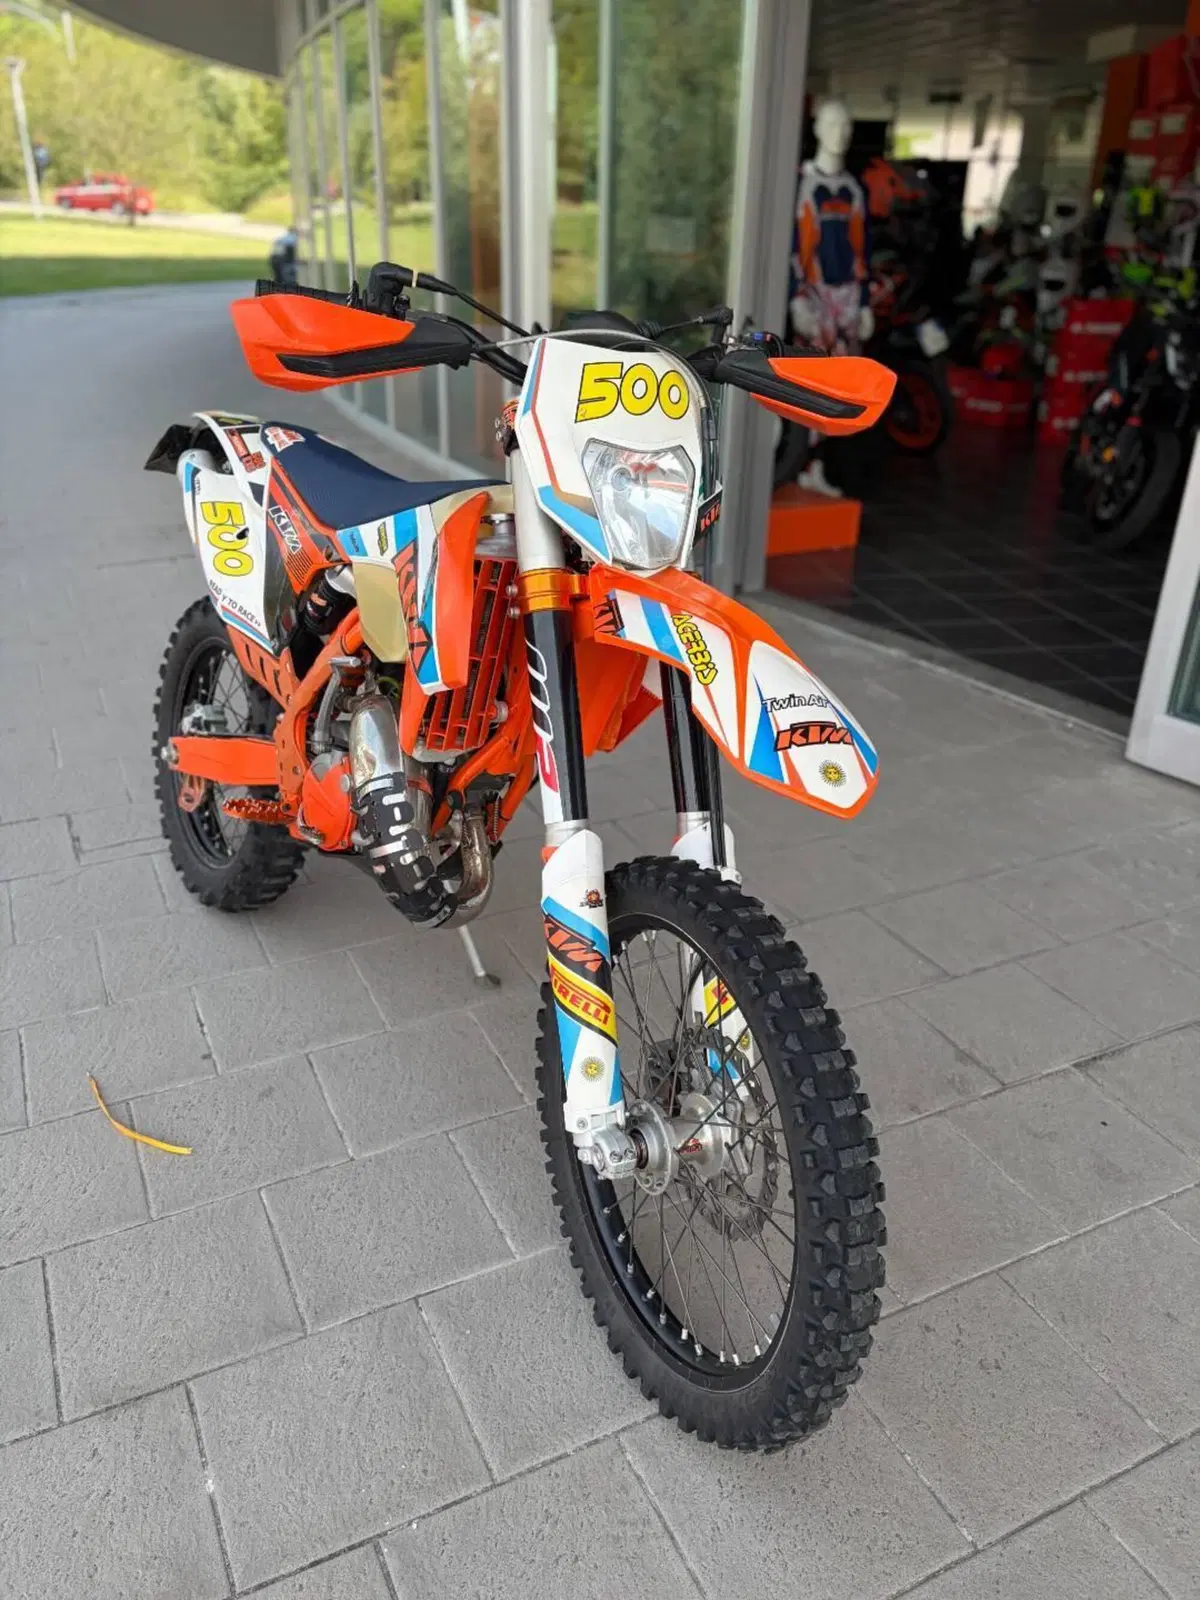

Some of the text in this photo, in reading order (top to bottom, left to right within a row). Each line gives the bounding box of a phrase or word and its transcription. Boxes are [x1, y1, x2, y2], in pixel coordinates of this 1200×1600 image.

[574, 361, 690, 424] 500
[200, 501, 253, 577] 500
[268, 505, 302, 555] KTM
[227, 596, 239, 610] TO
[238, 606, 257, 625] RACE
[762, 693, 807, 713] Twin
[774, 721, 854, 752] KTM
